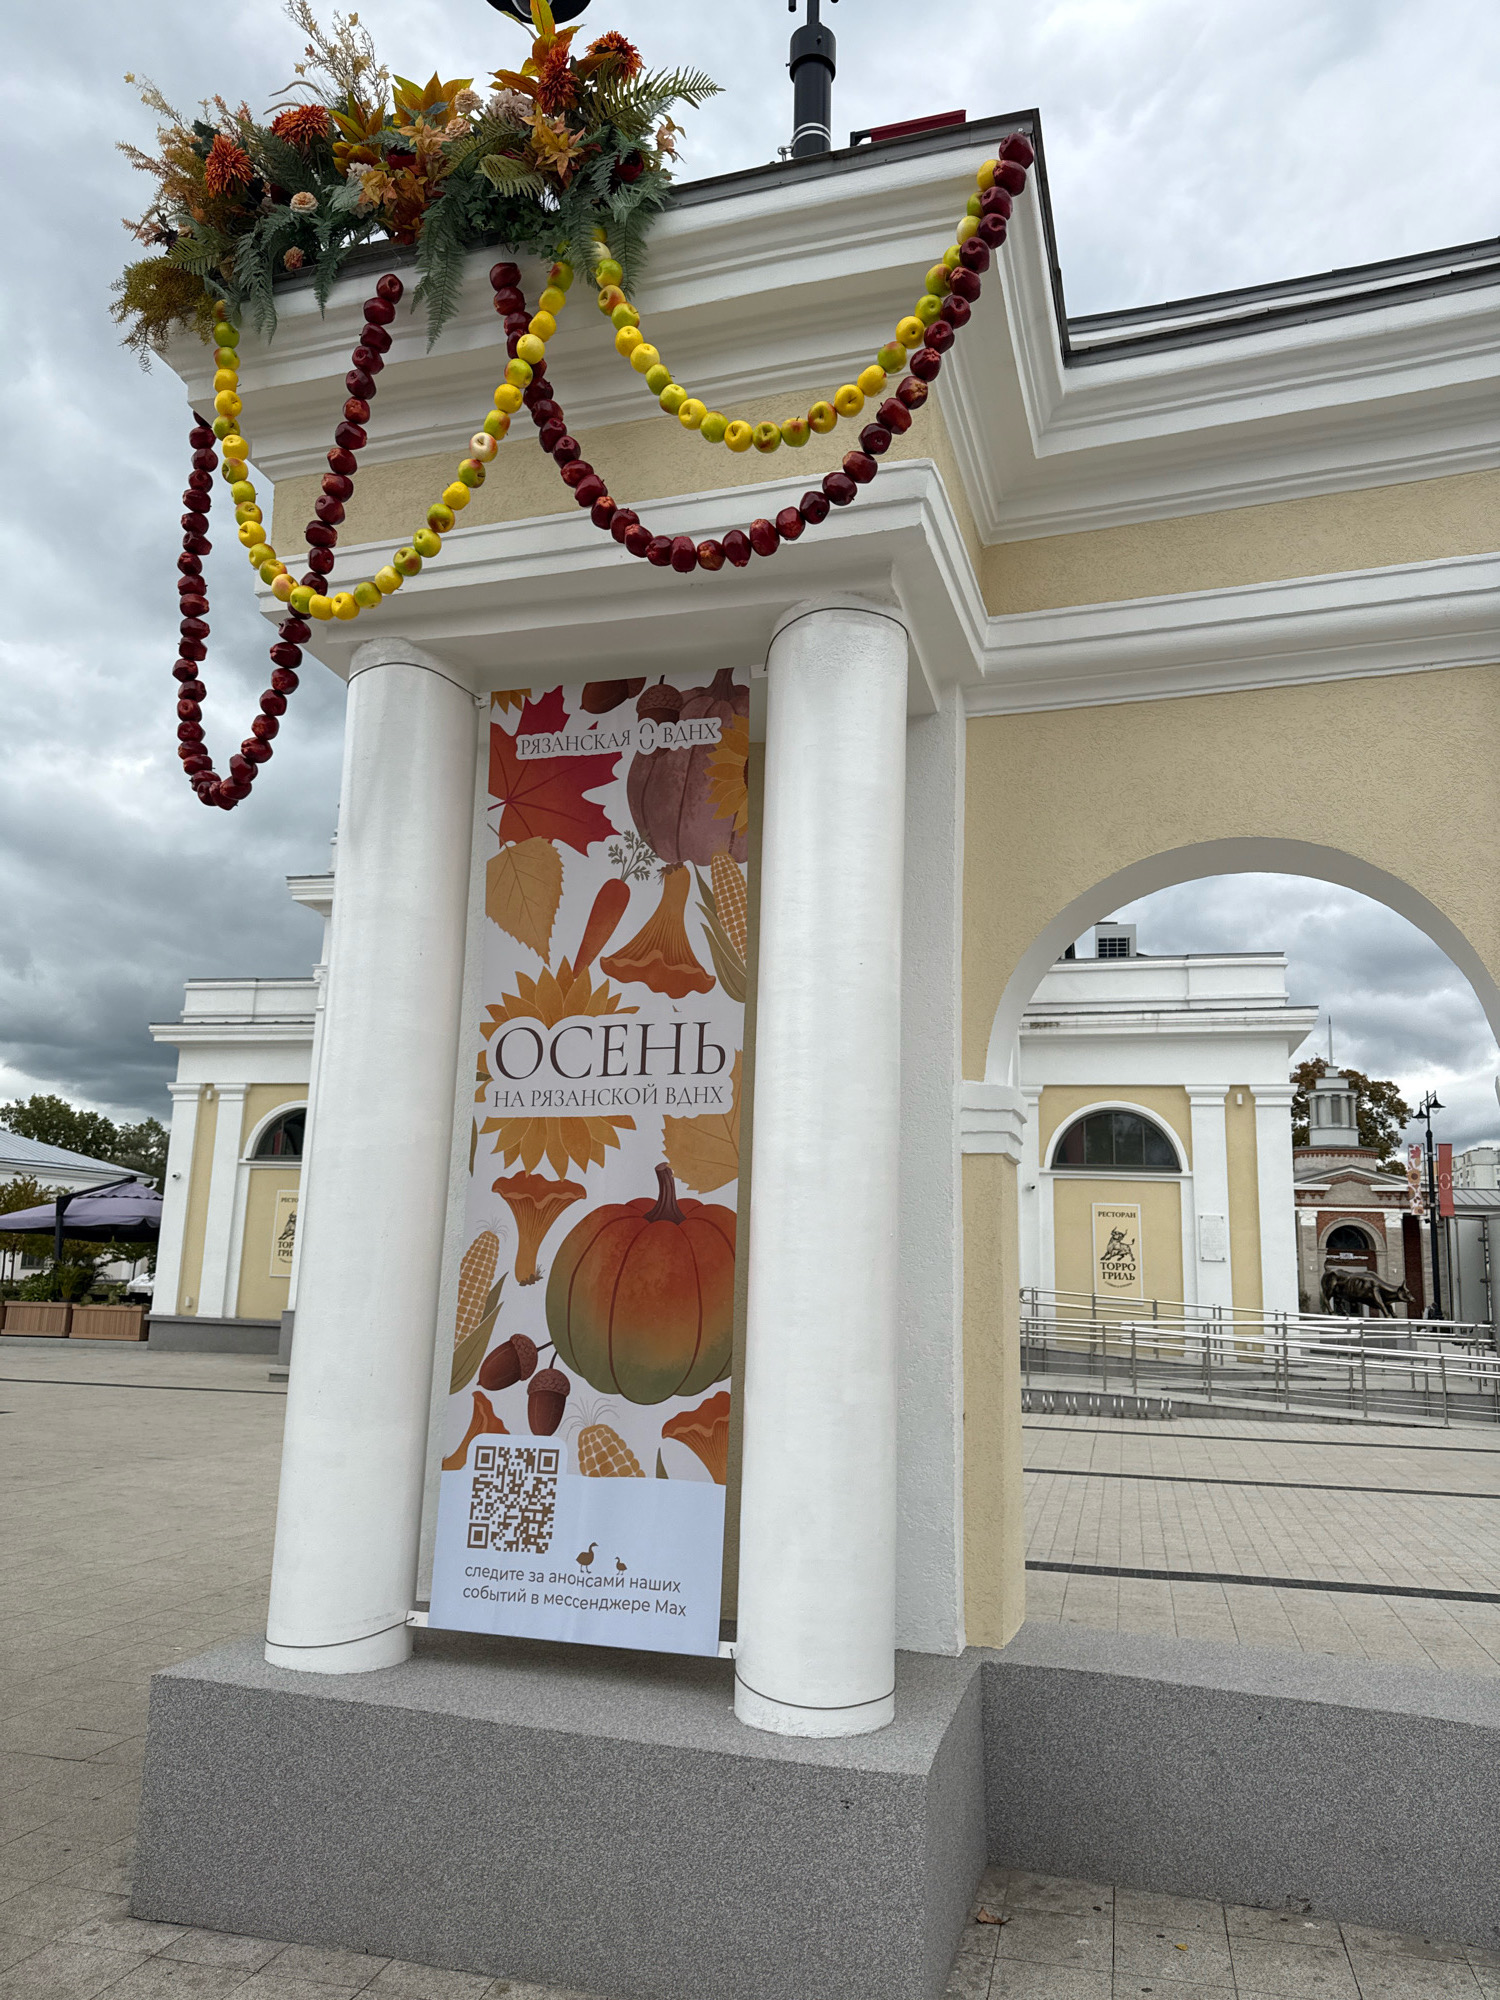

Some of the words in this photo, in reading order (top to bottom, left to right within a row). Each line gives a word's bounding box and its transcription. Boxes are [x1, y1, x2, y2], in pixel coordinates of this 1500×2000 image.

[520, 729, 631, 755] РЯЗАНСКАЯ
[663, 722, 717, 744] ВДНХ
[495, 1021, 726, 1080] ОСЕНЬ
[494, 1090, 524, 1107] НА
[530, 1083, 658, 1107] РЯЗАНСКОЙ
[665, 1086, 724, 1106] ВДНХ
[278, 1241, 294, 1249] ТОР
[1100, 1262, 1136, 1271] ТОРРО
[1102, 1271, 1135, 1280] ГРИЛЬ
[464, 1565, 524, 1582] следите
[528, 1571, 544, 1583] за
[548, 1571, 625, 1588] анонсами
[629, 1578, 681, 1593] наших
[463, 1585, 526, 1603] событий
[530, 1593, 539, 1604] в
[543, 1594, 650, 1614] мессенджере
